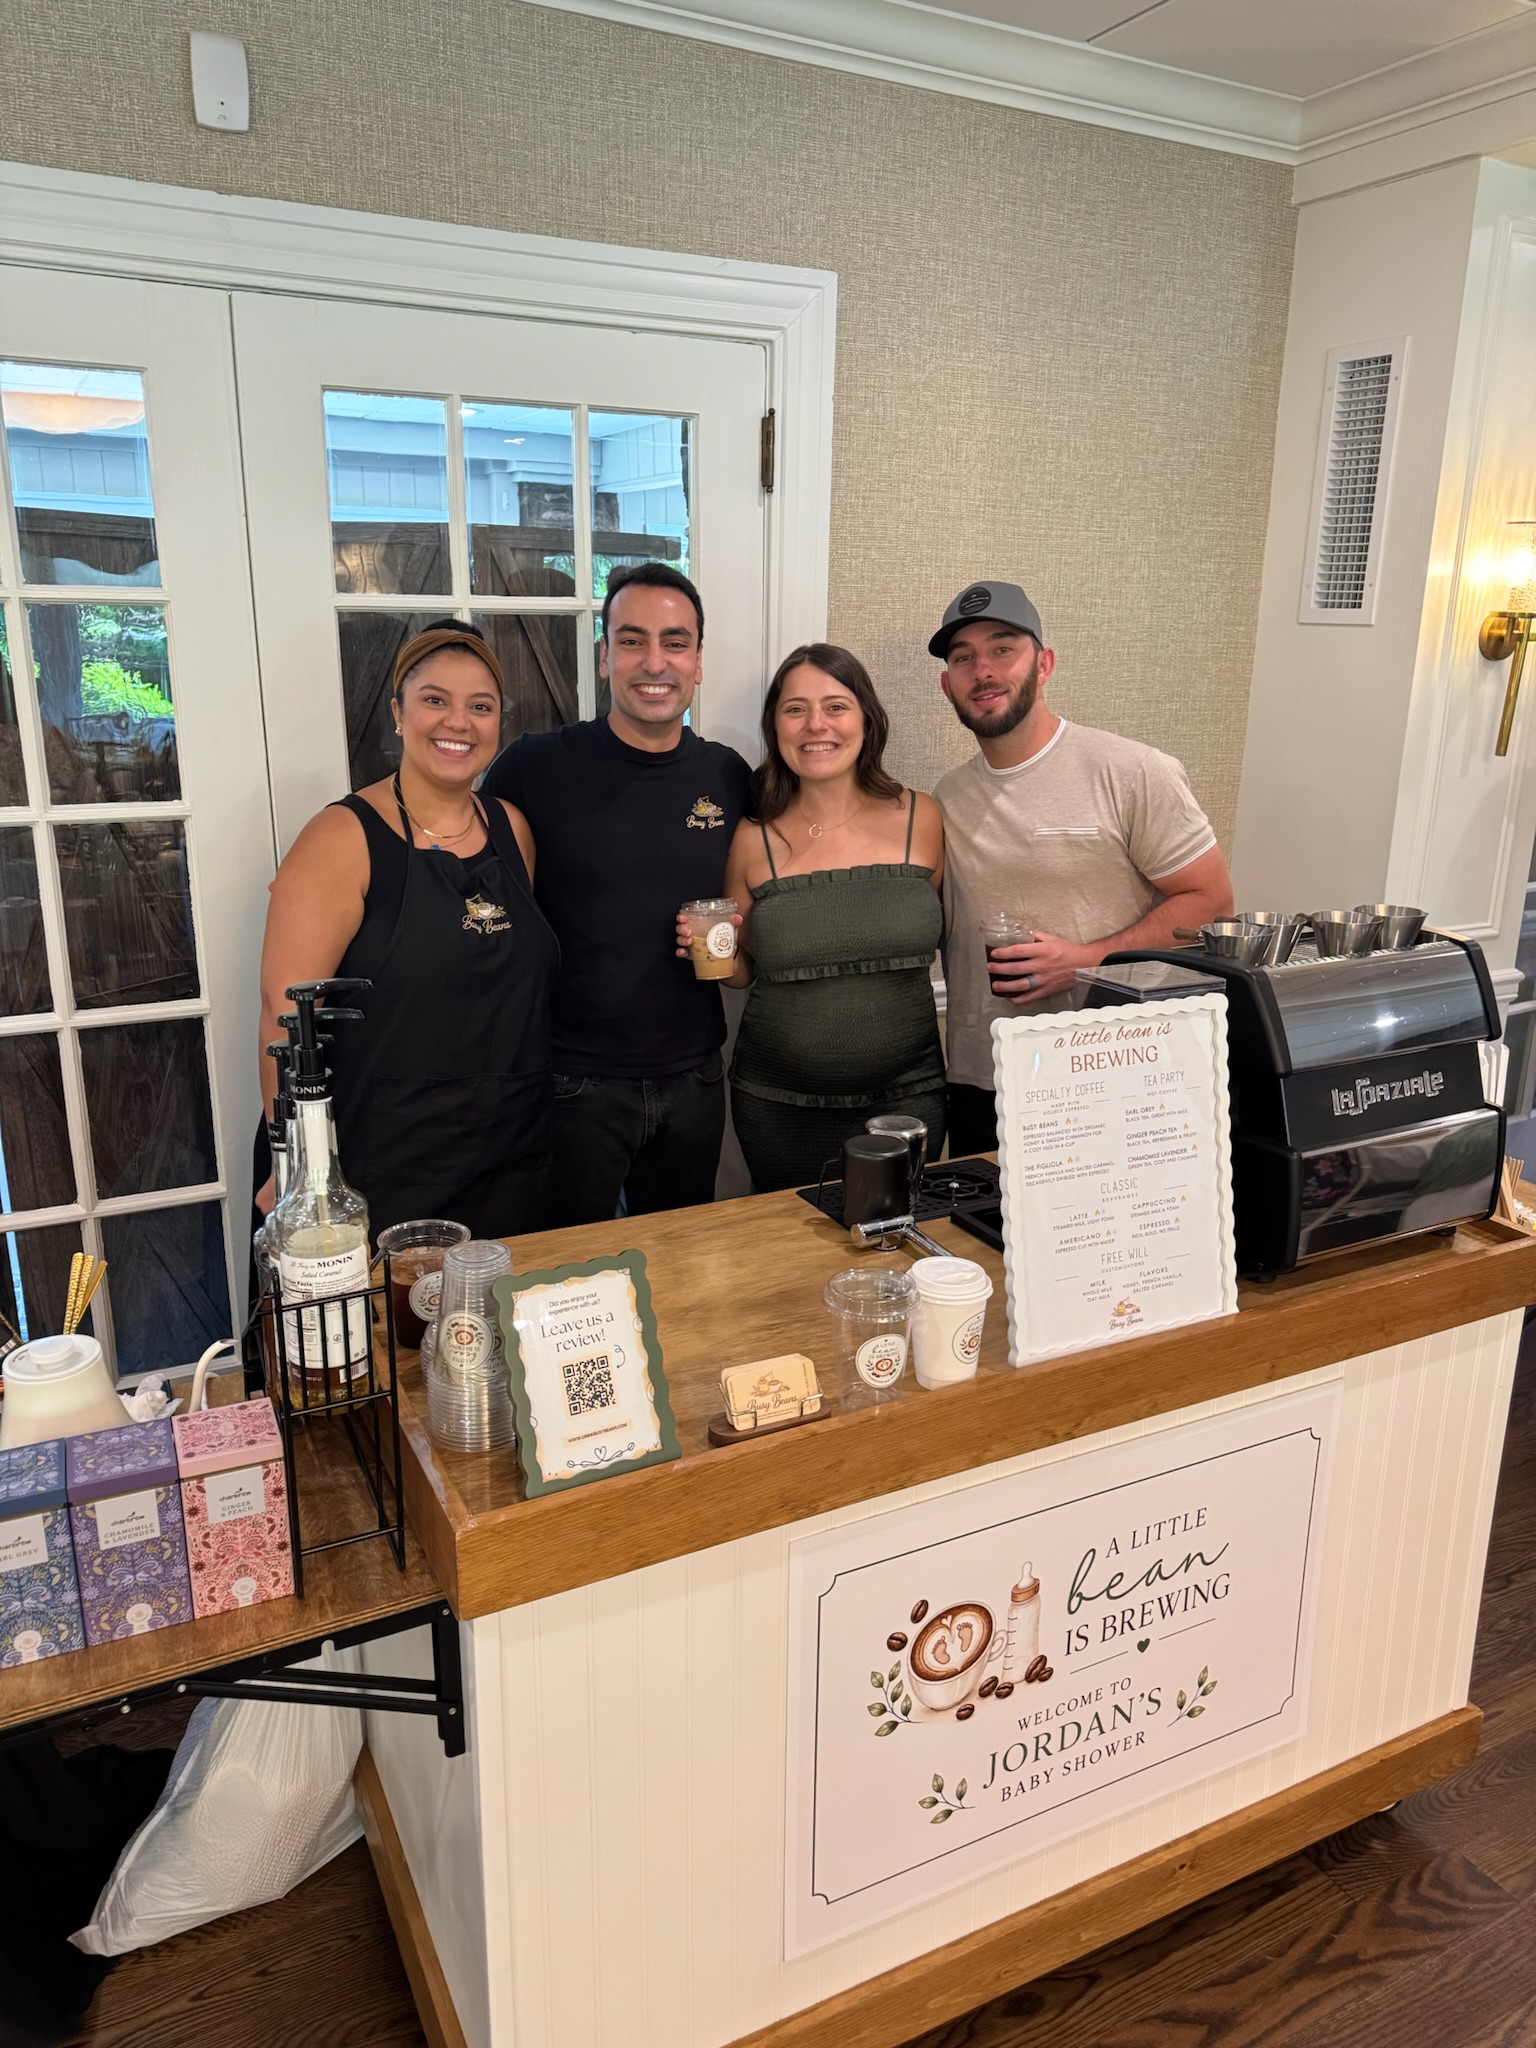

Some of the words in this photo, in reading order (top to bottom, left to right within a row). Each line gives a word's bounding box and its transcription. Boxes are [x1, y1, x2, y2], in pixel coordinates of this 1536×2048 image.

[482, 919, 513, 934] Beans
[1054, 1037, 1066, 1049] a
[1070, 1027, 1112, 1047] little
[1116, 1025, 1153, 1041] bean
[1156, 1022, 1173, 1036] is
[1071, 1045, 1158, 1073] BREWING
[1144, 1074, 1158, 1087] TEA
[1160, 1070, 1185, 1084] PARTY
[1025, 1086, 1071, 1103] SPECIALTY
[1075, 1081, 1105, 1096] COFFEE
[1023, 1132, 1046, 1140] ESPRESSO
[1126, 1130, 1148, 1140] GINGER
[1149, 1128, 1167, 1136] PEACH
[1152, 1135, 1177, 1143] REFRESHING
[1127, 1152, 1160, 1163] CHAMOMILE
[1161, 1148, 1187, 1157] LAVENDER
[1026, 1178, 1055, 1187] DECADENTLY
[1056, 1174, 1075, 1182] SWIRLED
[1088, 1168, 1110, 1177] ESPRESSO
[1045, 1169, 1064, 1177] VANILLA
[1100, 1177, 1138, 1194] CLASSIC
[1102, 1192, 1138, 1203] BEVERAGES
[1131, 1197, 1176, 1210] CAPPUCCINO
[1069, 1213, 1088, 1222] LATTE
[1053, 1223, 1073, 1231] STEAMED
[1139, 1219, 1171, 1231] ESPRESSO
[1059, 1232, 1101, 1245] AMERICANO
[1055, 1246, 1077, 1254] ESPRESSO
[1101, 1250, 1123, 1265] FREE
[1127, 1246, 1149, 1260] WILL
[317, 1256, 353, 1268] MONIN
[1101, 1261, 1145, 1273] CUSTOMIZATIONS
[319, 1267, 343, 1278] Caramel
[1139, 1266, 1168, 1277] FLAVORS
[1142, 1277, 1161, 1285] FRENCH
[1151, 1281, 1174, 1290] CARAMEL
[585, 1292, 597, 1300] your
[548, 1305, 579, 1315] experience
[591, 1298, 601, 1306] us?
[541, 1319, 583, 1338] Leave
[586, 1314, 603, 1327] us
[605, 1312, 614, 1323] a
[556, 1328, 606, 1353] review!
[746, 1399, 770, 1412] Busy
[772, 1393, 798, 1409] Beans
[221, 1501, 251, 1511] GINGER
[228, 1506, 253, 1515] PEACH
[103, 1522, 154, 1538] CHAMOMILE
[112, 1529, 155, 1543] LAVENDER
[1105, 1537, 1120, 1558] A
[1130, 1507, 1208, 1550] LITTLE
[16, 1548, 39, 1557] GREY
[1067, 1542, 1230, 1615] bean
[1064, 1624, 1089, 1656] IS
[1100, 1573, 1231, 1643] BREWING
[1017, 1688, 1104, 1731] WELCOME
[1110, 1677, 1132, 1696] TO
[982, 1687, 1162, 1789] JORDAN'S
[1000, 1768, 1055, 1803] BABY
[1061, 1731, 1146, 1777] SHOWER
